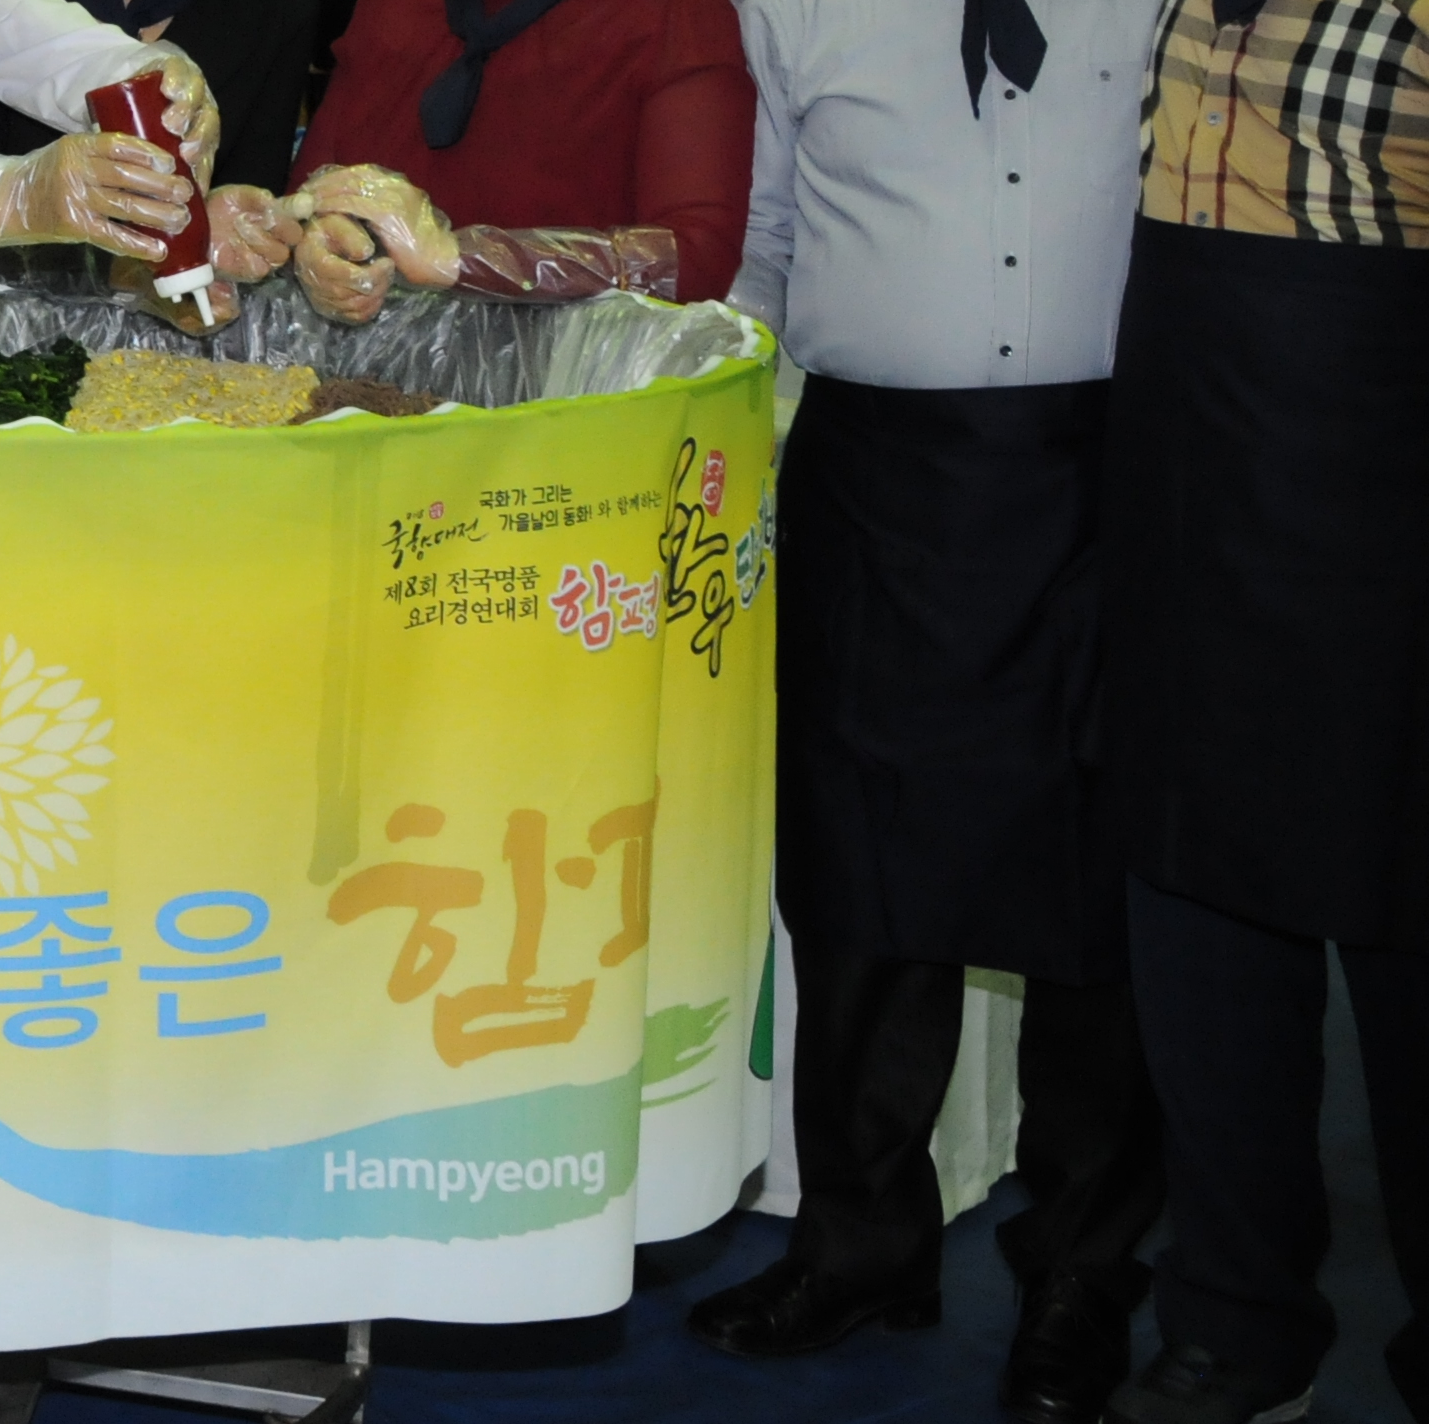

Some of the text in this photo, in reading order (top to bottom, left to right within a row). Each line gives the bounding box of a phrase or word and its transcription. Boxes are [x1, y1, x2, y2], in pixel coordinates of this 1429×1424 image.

[479, 484, 573, 510] 국화가 그리는
[498, 509, 559, 533] 가을날의
[383, 564, 541, 603] 제8회 전국명품
[403, 594, 540, 631] 요리경연대회
[549, 560, 661, 652] 함평
[323, 1148, 606, 1203] Hampyeong
